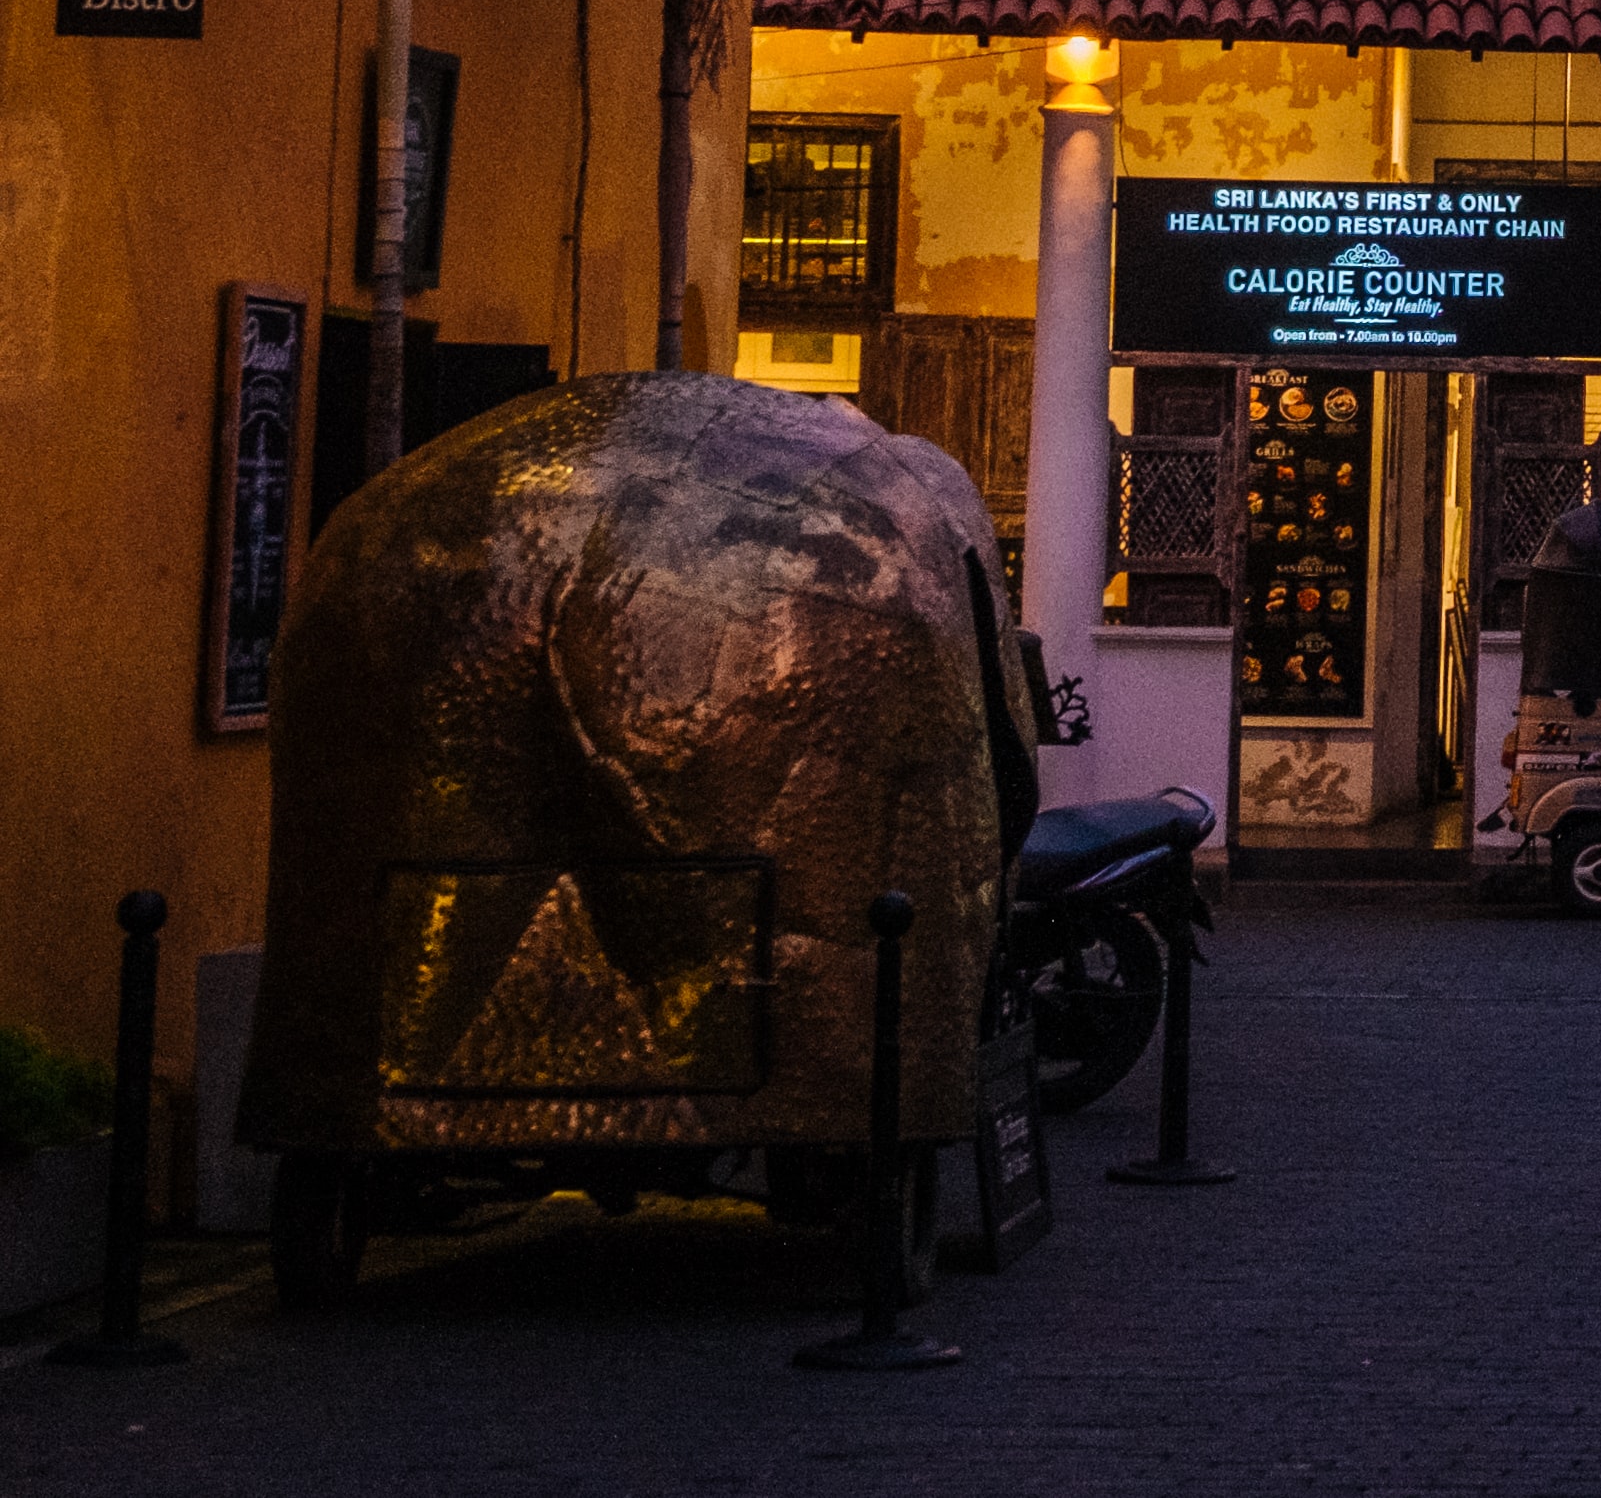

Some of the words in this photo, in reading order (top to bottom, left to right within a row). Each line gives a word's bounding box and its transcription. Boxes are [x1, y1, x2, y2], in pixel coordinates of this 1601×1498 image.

[1215, 189, 1254, 208] SRI
[1259, 189, 1359, 210] LANKA'S
[1367, 192, 1430, 212] FIRST
[1438, 193, 1452, 211] &
[1460, 193, 1522, 213] ONLY
[1168, 213, 1259, 233] HEALTH
[1267, 214, 1330, 235] FOOD
[1338, 216, 1489, 237] RESTAURANT
[1495, 219, 1565, 239] CHAIN
[1227, 268, 1354, 295] CALORIE
[1364, 269, 1505, 298] COUNTER
[1289, 296, 1311, 313] Eat
[1312, 295, 1361, 317] Healthy,
[1364, 297, 1393, 318] Stay
[1272, 328, 1306, 344] Open
[1308, 329, 1337, 342] from
[1391, 330, 1405, 342] to
